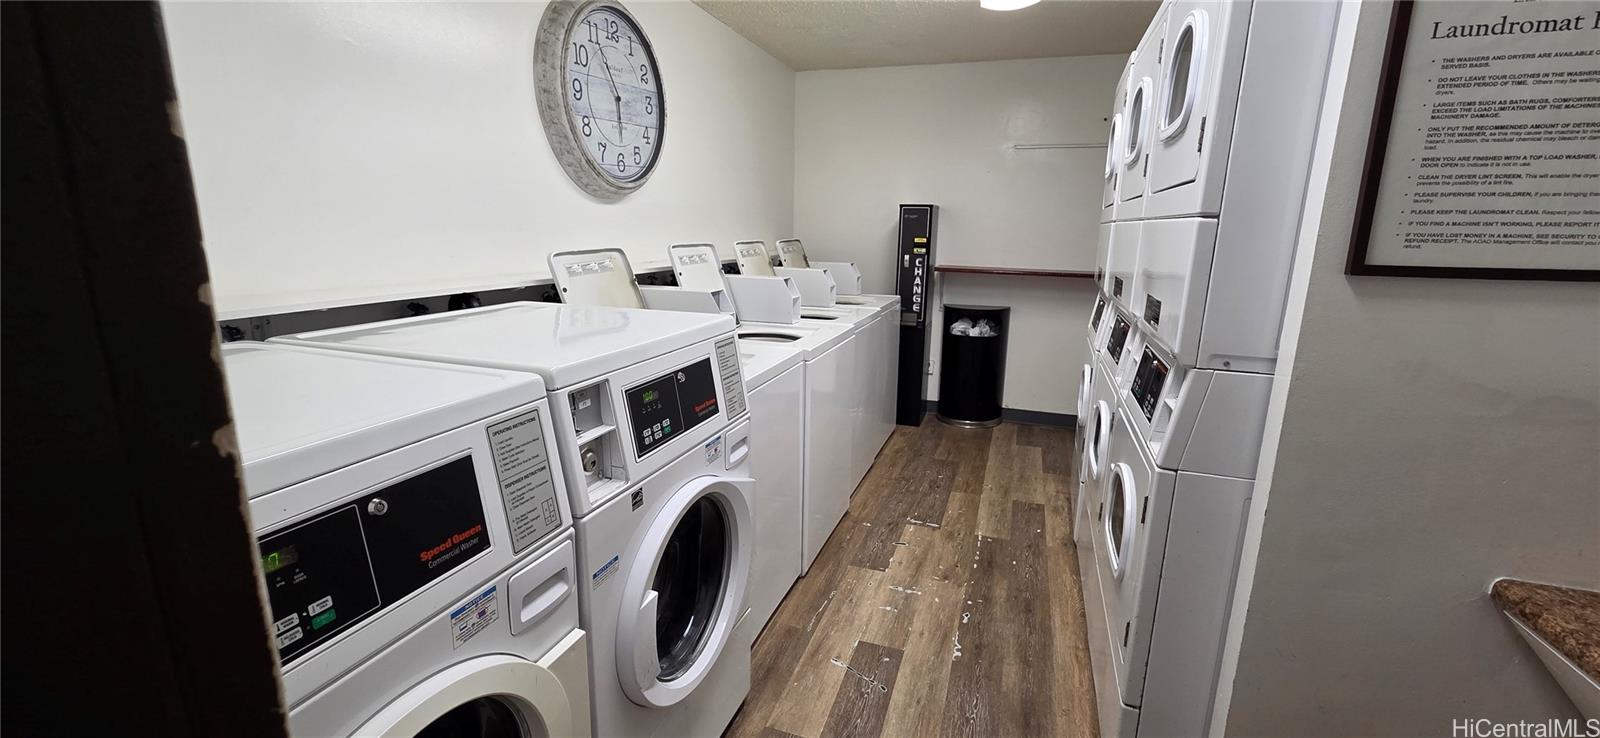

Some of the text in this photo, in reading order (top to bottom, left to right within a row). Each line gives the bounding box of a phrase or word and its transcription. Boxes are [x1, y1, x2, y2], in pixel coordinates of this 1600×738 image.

[587, 20, 600, 45] 11
[604, 18, 620, 43] 12
[1430, 15, 1585, 39] Laundromat
[572, 42, 588, 68] 10
[628, 36, 634, 56] 1
[640, 64, 648, 84] 2
[572, 78, 582, 100] 9
[645, 96, 653, 115] 3
[582, 116, 592, 137] 8
[642, 126, 650, 144] 4
[598, 142, 606, 162] 7
[616, 152, 626, 172] 6
[634, 146, 641, 165] 5
[912, 258, 923, 312] CHANGE
[492, 416, 536, 437] OPERATING INSTRUCTIONS
[504, 465, 546, 489] DISPENSER INSTRUCTIONS
[420, 524, 481, 561] Speed Queen
[428, 537, 479, 569] Commercial Washer
